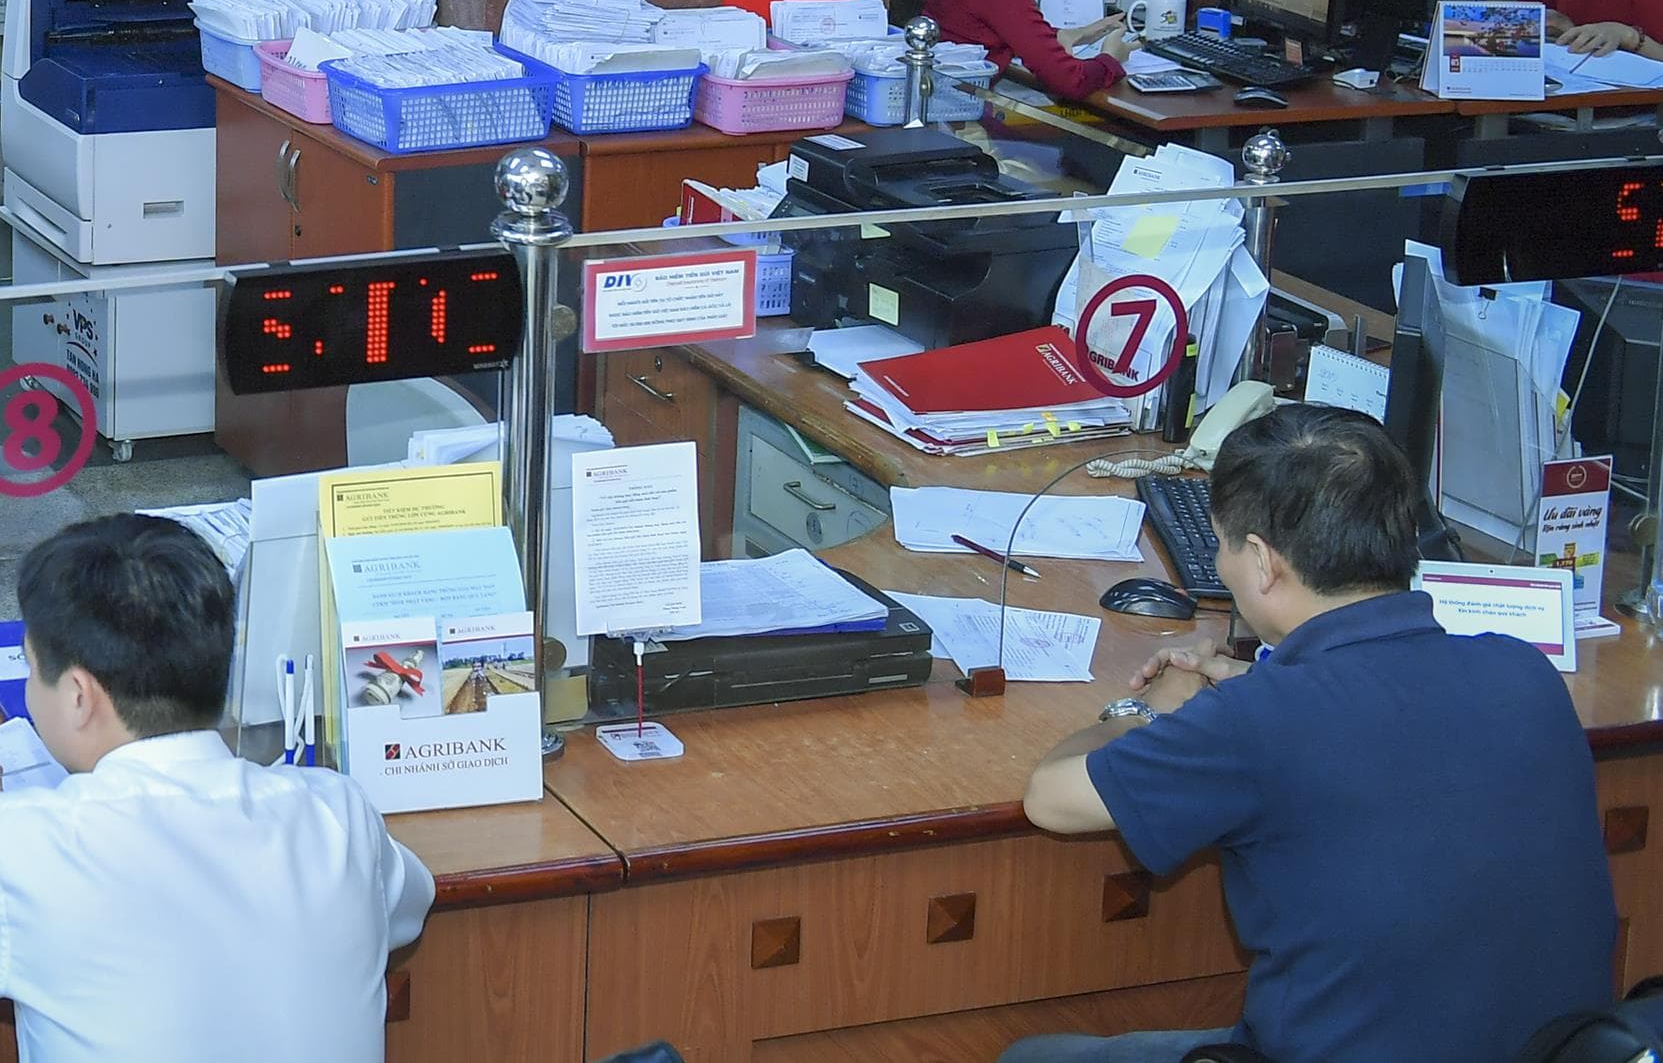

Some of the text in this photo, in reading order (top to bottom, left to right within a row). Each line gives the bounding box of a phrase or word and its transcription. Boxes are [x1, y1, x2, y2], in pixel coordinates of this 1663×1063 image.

[73, 308, 93, 340] VPS
[1111, 299, 1157, 373] 7
[1042, 347, 1077, 385] AGRIBANK
[3, 390, 61, 471] 8
[346, 491, 389, 502] AGRIBANK
[1578, 504, 1602, 521] vàng
[365, 561, 421, 573] AGRIBANK
[405, 737, 507, 760] AGRIBANK
[384, 756, 508, 776] CHI NHÁNH SỞ GIAO DỊCH
